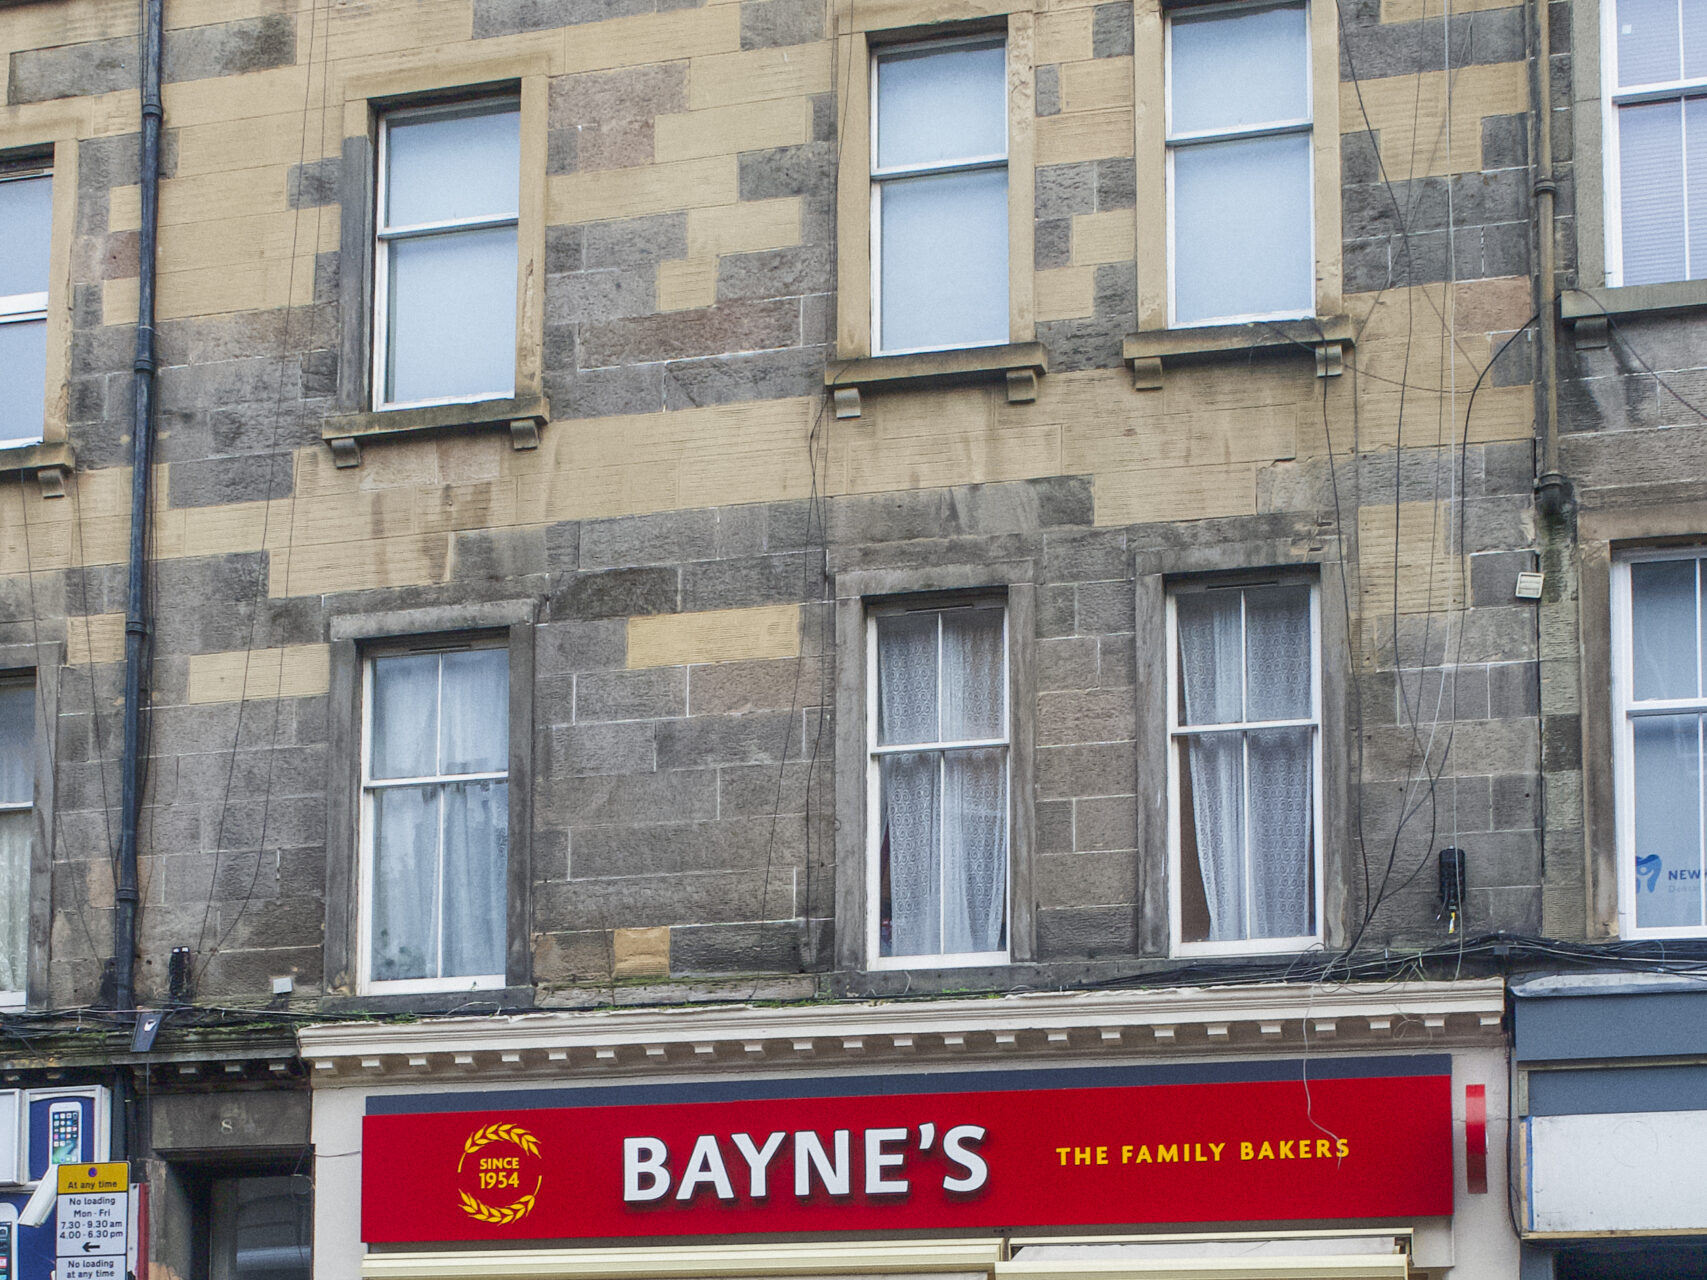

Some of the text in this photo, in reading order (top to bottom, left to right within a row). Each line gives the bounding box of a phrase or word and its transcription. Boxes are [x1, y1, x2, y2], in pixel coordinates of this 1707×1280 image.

[1668, 869, 1700, 880] NEW
[220, 1118, 233, 1135] 8
[1056, 1138, 1351, 1166] THE FAMILY BAKERS
[479, 1156, 520, 1171] SINCE
[623, 1122, 989, 1202] BAYNE'S
[68, 1181, 78, 1189] At
[80, 1182, 96, 1190] any
[479, 1172, 521, 1190] 1954
[69, 1197, 116, 1206] No loading
[73, 1210, 92, 1218] Mon
[99, 1209, 111, 1217] Fri
[61, 1221, 81, 1229] 7.30
[87, 1220, 108, 1229] 9.30
[60, 1230, 81, 1239] 4.00
[88, 1230, 109, 1239] 6.30
[110, 1231, 124, 1239] pm
[68, 1260, 114, 1269] No loading
[66, 1271, 76, 1279] at
